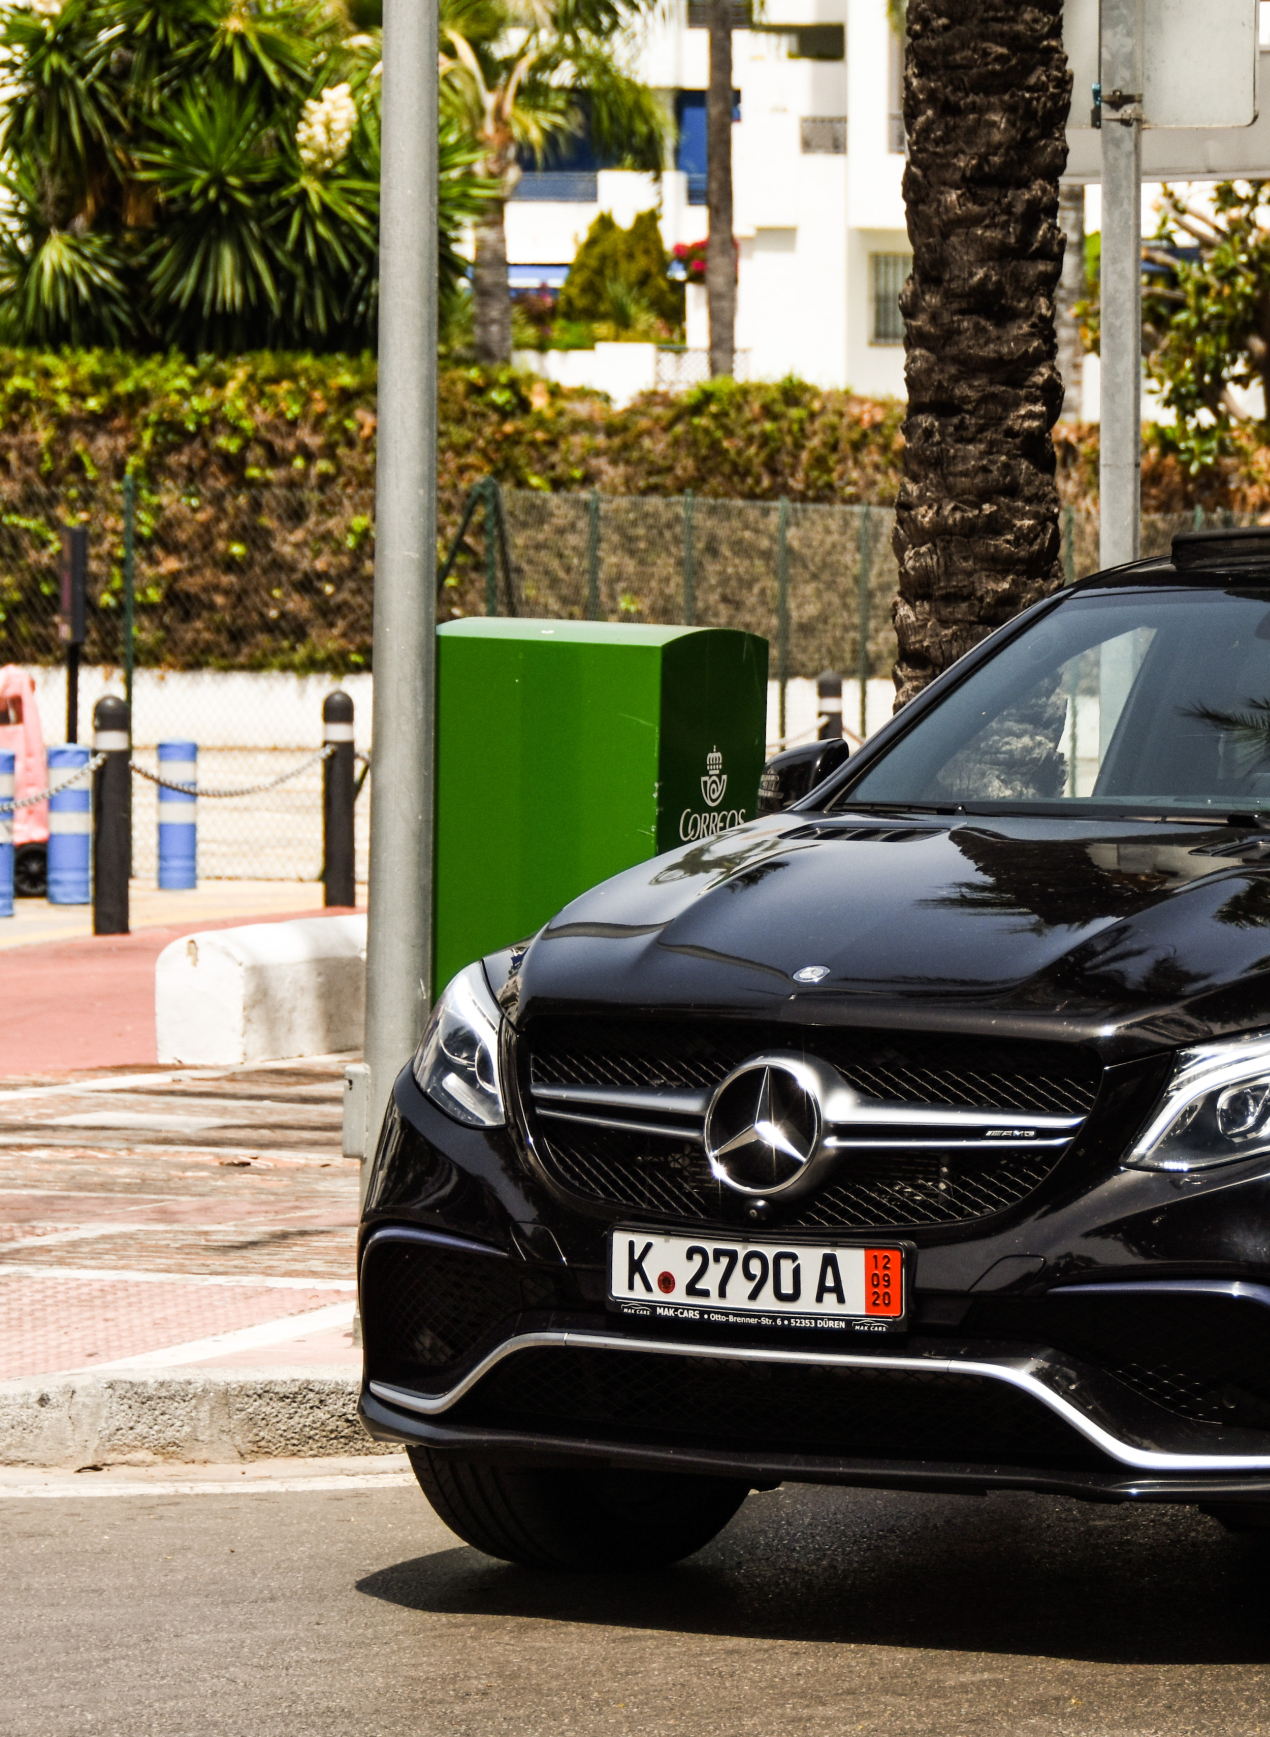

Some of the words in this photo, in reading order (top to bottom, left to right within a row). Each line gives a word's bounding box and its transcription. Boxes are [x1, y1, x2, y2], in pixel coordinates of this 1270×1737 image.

[679, 808, 746, 841] CORREOS
[873, 1253, 891, 1270] 12
[627, 1240, 654, 1293] K
[685, 1245, 802, 1302] 2790
[815, 1252, 846, 1304] A
[871, 1272, 891, 1289] 09
[872, 1290, 891, 1307] 20
[656, 1306, 700, 1319] MAK-CARS
[709, 1313, 775, 1326] Otto-Brenner-Str.
[776, 1317, 782, 1325] 6
[790, 1318, 815, 1327] 52353
[817, 1318, 846, 1329] DÜREN
